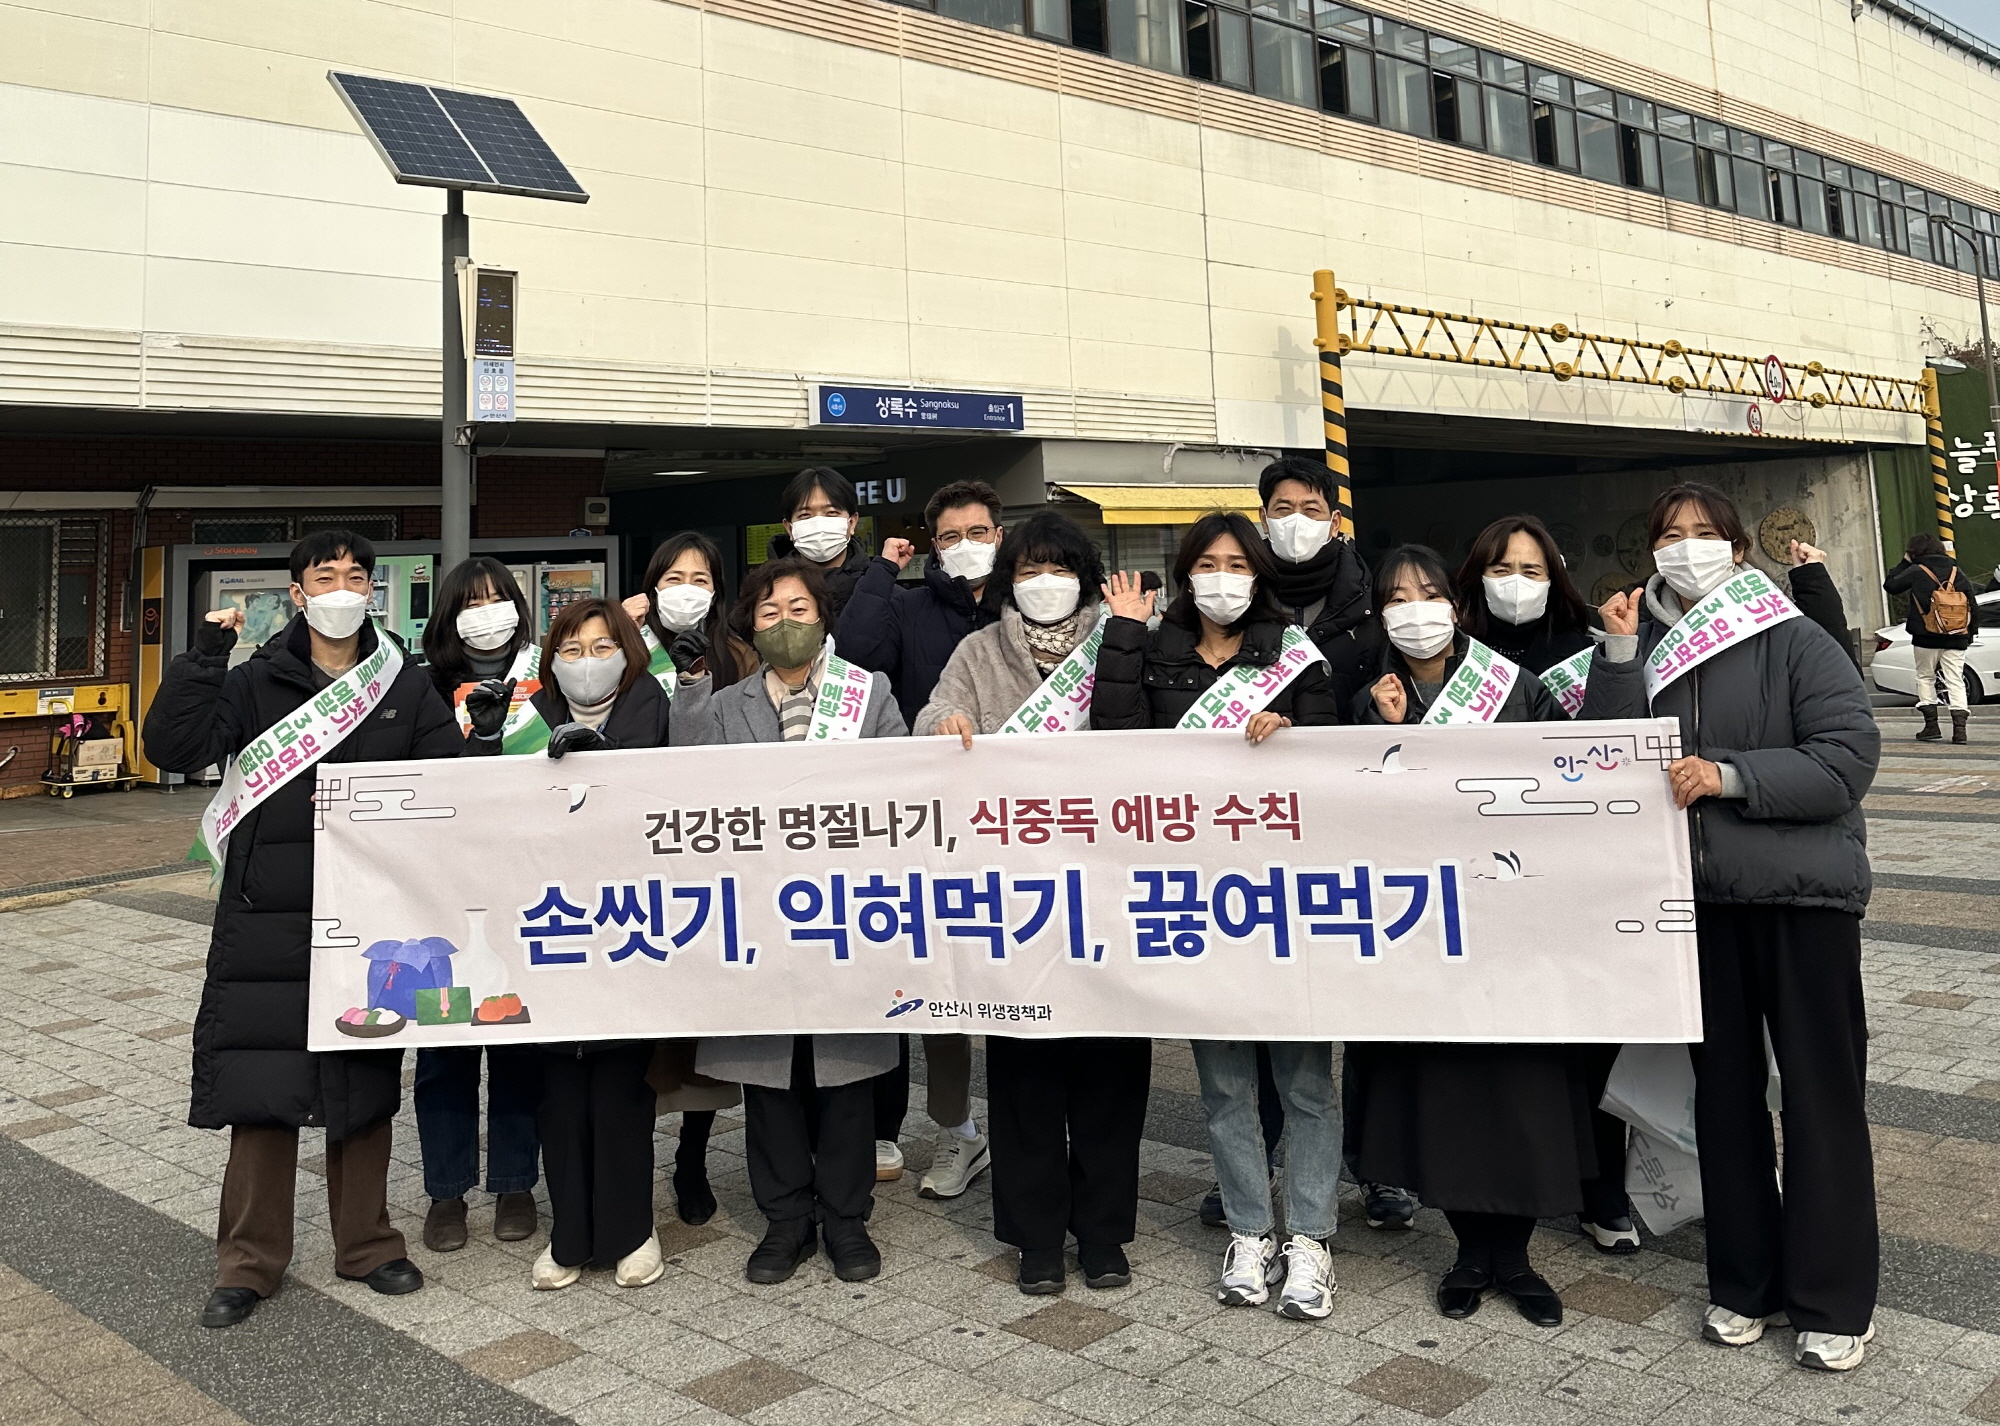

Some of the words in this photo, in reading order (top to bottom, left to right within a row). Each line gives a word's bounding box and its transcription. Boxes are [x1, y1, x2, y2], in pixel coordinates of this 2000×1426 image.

[876, 396, 918, 419] 상록수
[920, 398, 960, 411] Sangnoksu
[983, 414, 1006, 423] Entrance
[987, 404, 1006, 414] 출입구
[1007, 402, 1015, 423] 1
[215, 546, 258, 555] Storyway
[1724, 573, 1771, 604] 예방
[1684, 597, 1724, 632] 3대
[1651, 629, 1685, 667] 요령
[1655, 618, 1736, 681] 익혀먹기
[1049, 658, 1086, 697] 예방
[1446, 665, 1484, 707] 예방
[313, 681, 356, 717] 예방
[817, 682, 844, 719] 예방
[1199, 682, 1236, 714] 3대
[273, 712, 313, 748] 3대
[238, 739, 273, 777] 요령
[245, 735, 321, 798] 익혀먹기
[645, 806, 766, 855] 건강한
[778, 799, 957, 853] 명절나기,
[971, 797, 1099, 845] 식중독
[1112, 794, 1199, 843] 예방
[1213, 792, 1301, 841] 수칙
[520, 877, 757, 965] 손씻기,
[778, 870, 1104, 963] 익혀먹기,
[1128, 865, 1463, 958] 끓여먹기
[928, 1001, 973, 1018] 안산시
[977, 1002, 1052, 1022] 위생정책과
